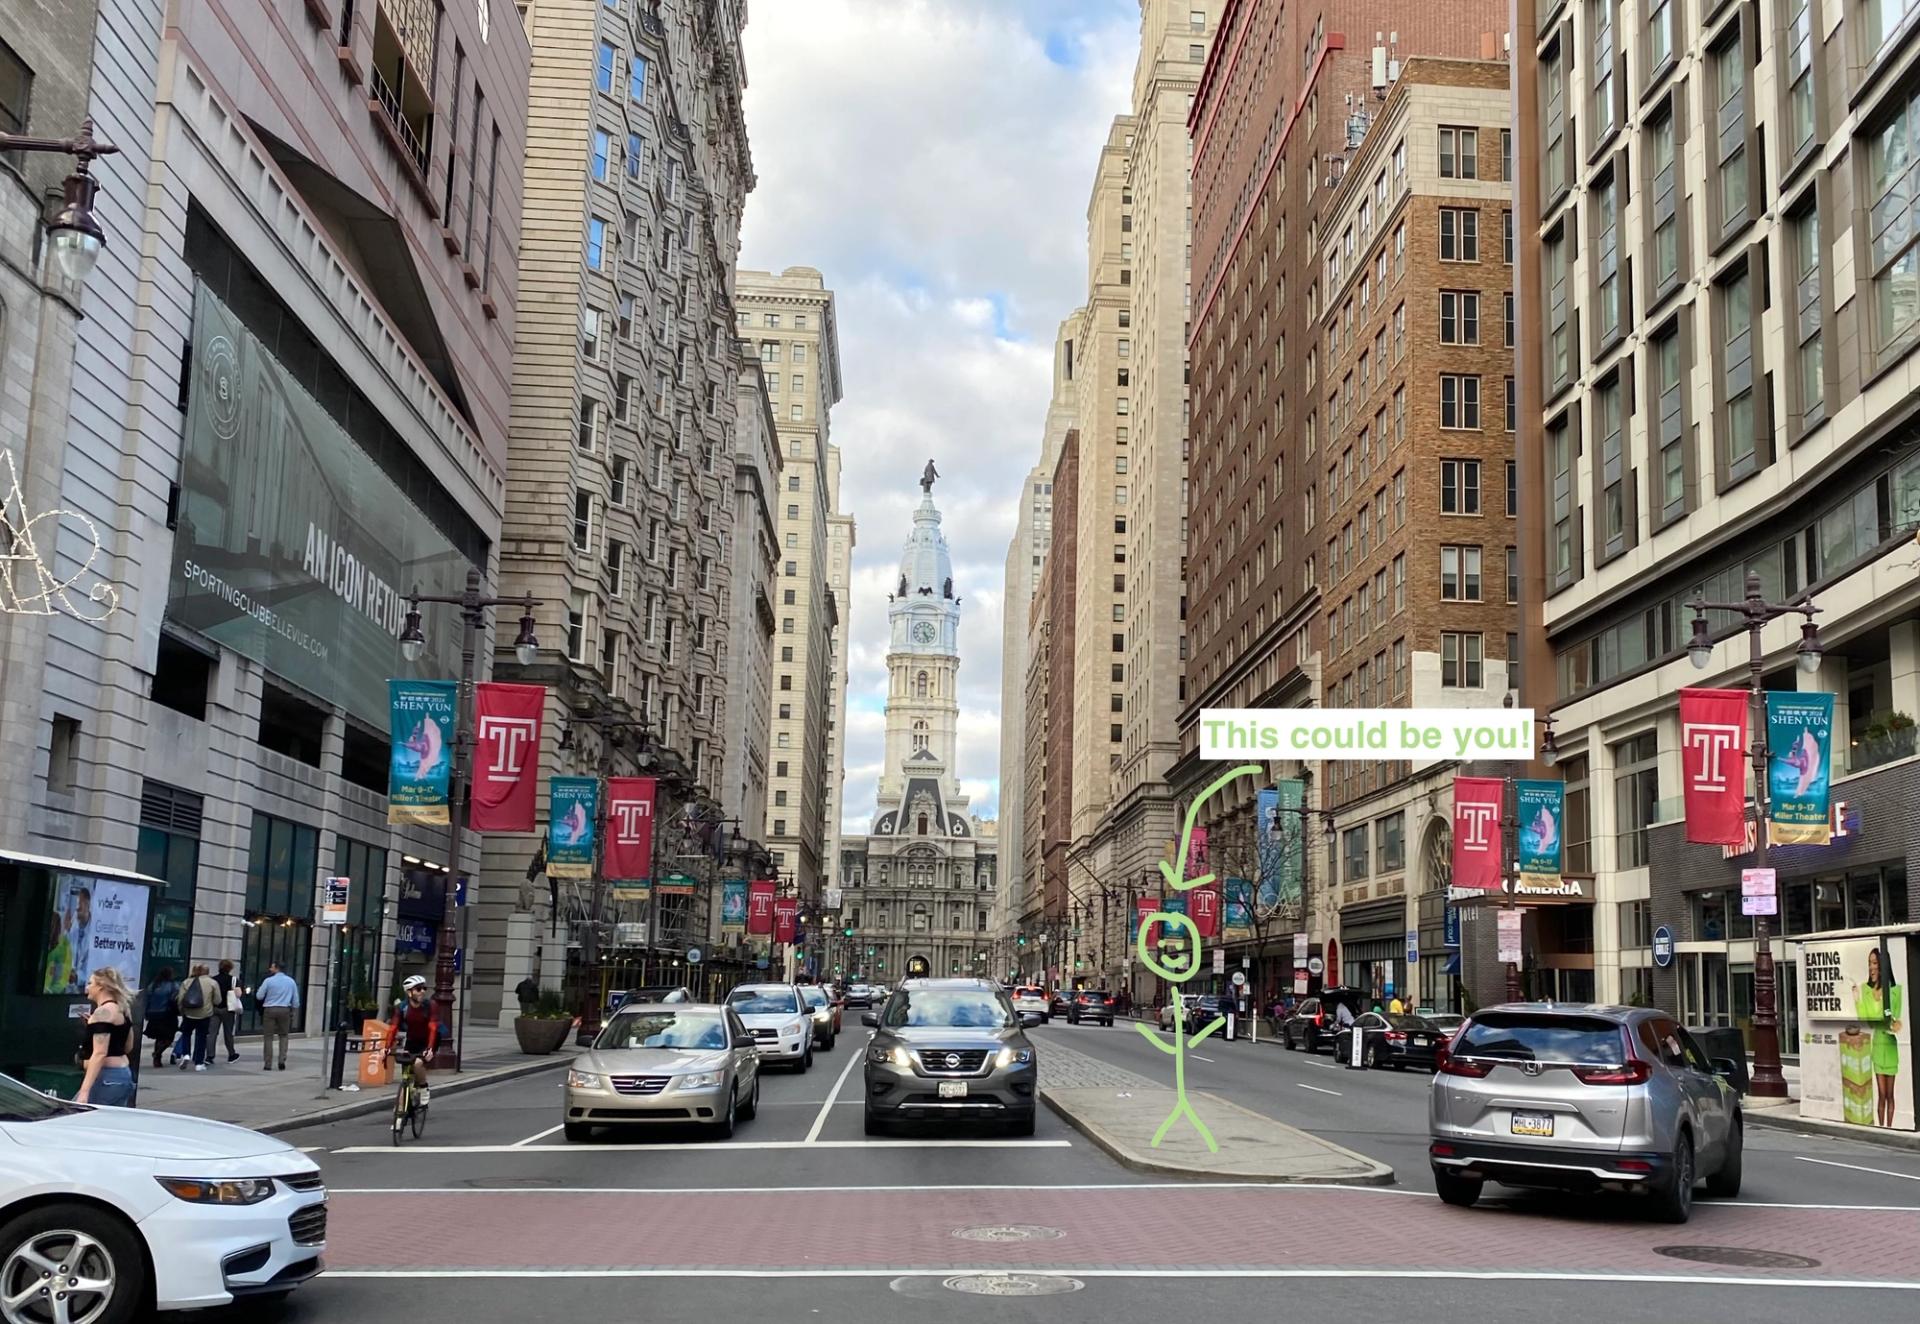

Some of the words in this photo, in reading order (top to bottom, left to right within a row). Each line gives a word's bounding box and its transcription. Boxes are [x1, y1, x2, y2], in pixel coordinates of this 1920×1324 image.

[303, 522, 328, 584] AN
[328, 541, 366, 612] ICON
[183, 559, 329, 664] SPORTINGCLUBBELLEVUE.COM
[393, 701, 424, 711] SHEN
[427, 702, 452, 712] YUN
[1770, 714, 1802, 725] SHEN
[1806, 715, 1829, 726] YUN
[553, 791, 576, 799] SHEN
[577, 791, 594, 800] YUN
[1519, 796, 1539, 804] SHEN
[1543, 796, 1561, 805] YUN
[1781, 802, 1796, 811] Mar
[1795, 812, 1827, 821] Theater
[93, 936, 117, 950] Better
[117, 938, 136, 954] vybe.
[1805, 951, 1841, 967] EATING
[1806, 966, 1844, 982] BETTER.
[1806, 982, 1836, 997] MADE
[1807, 997, 1842, 1012] BETTER
